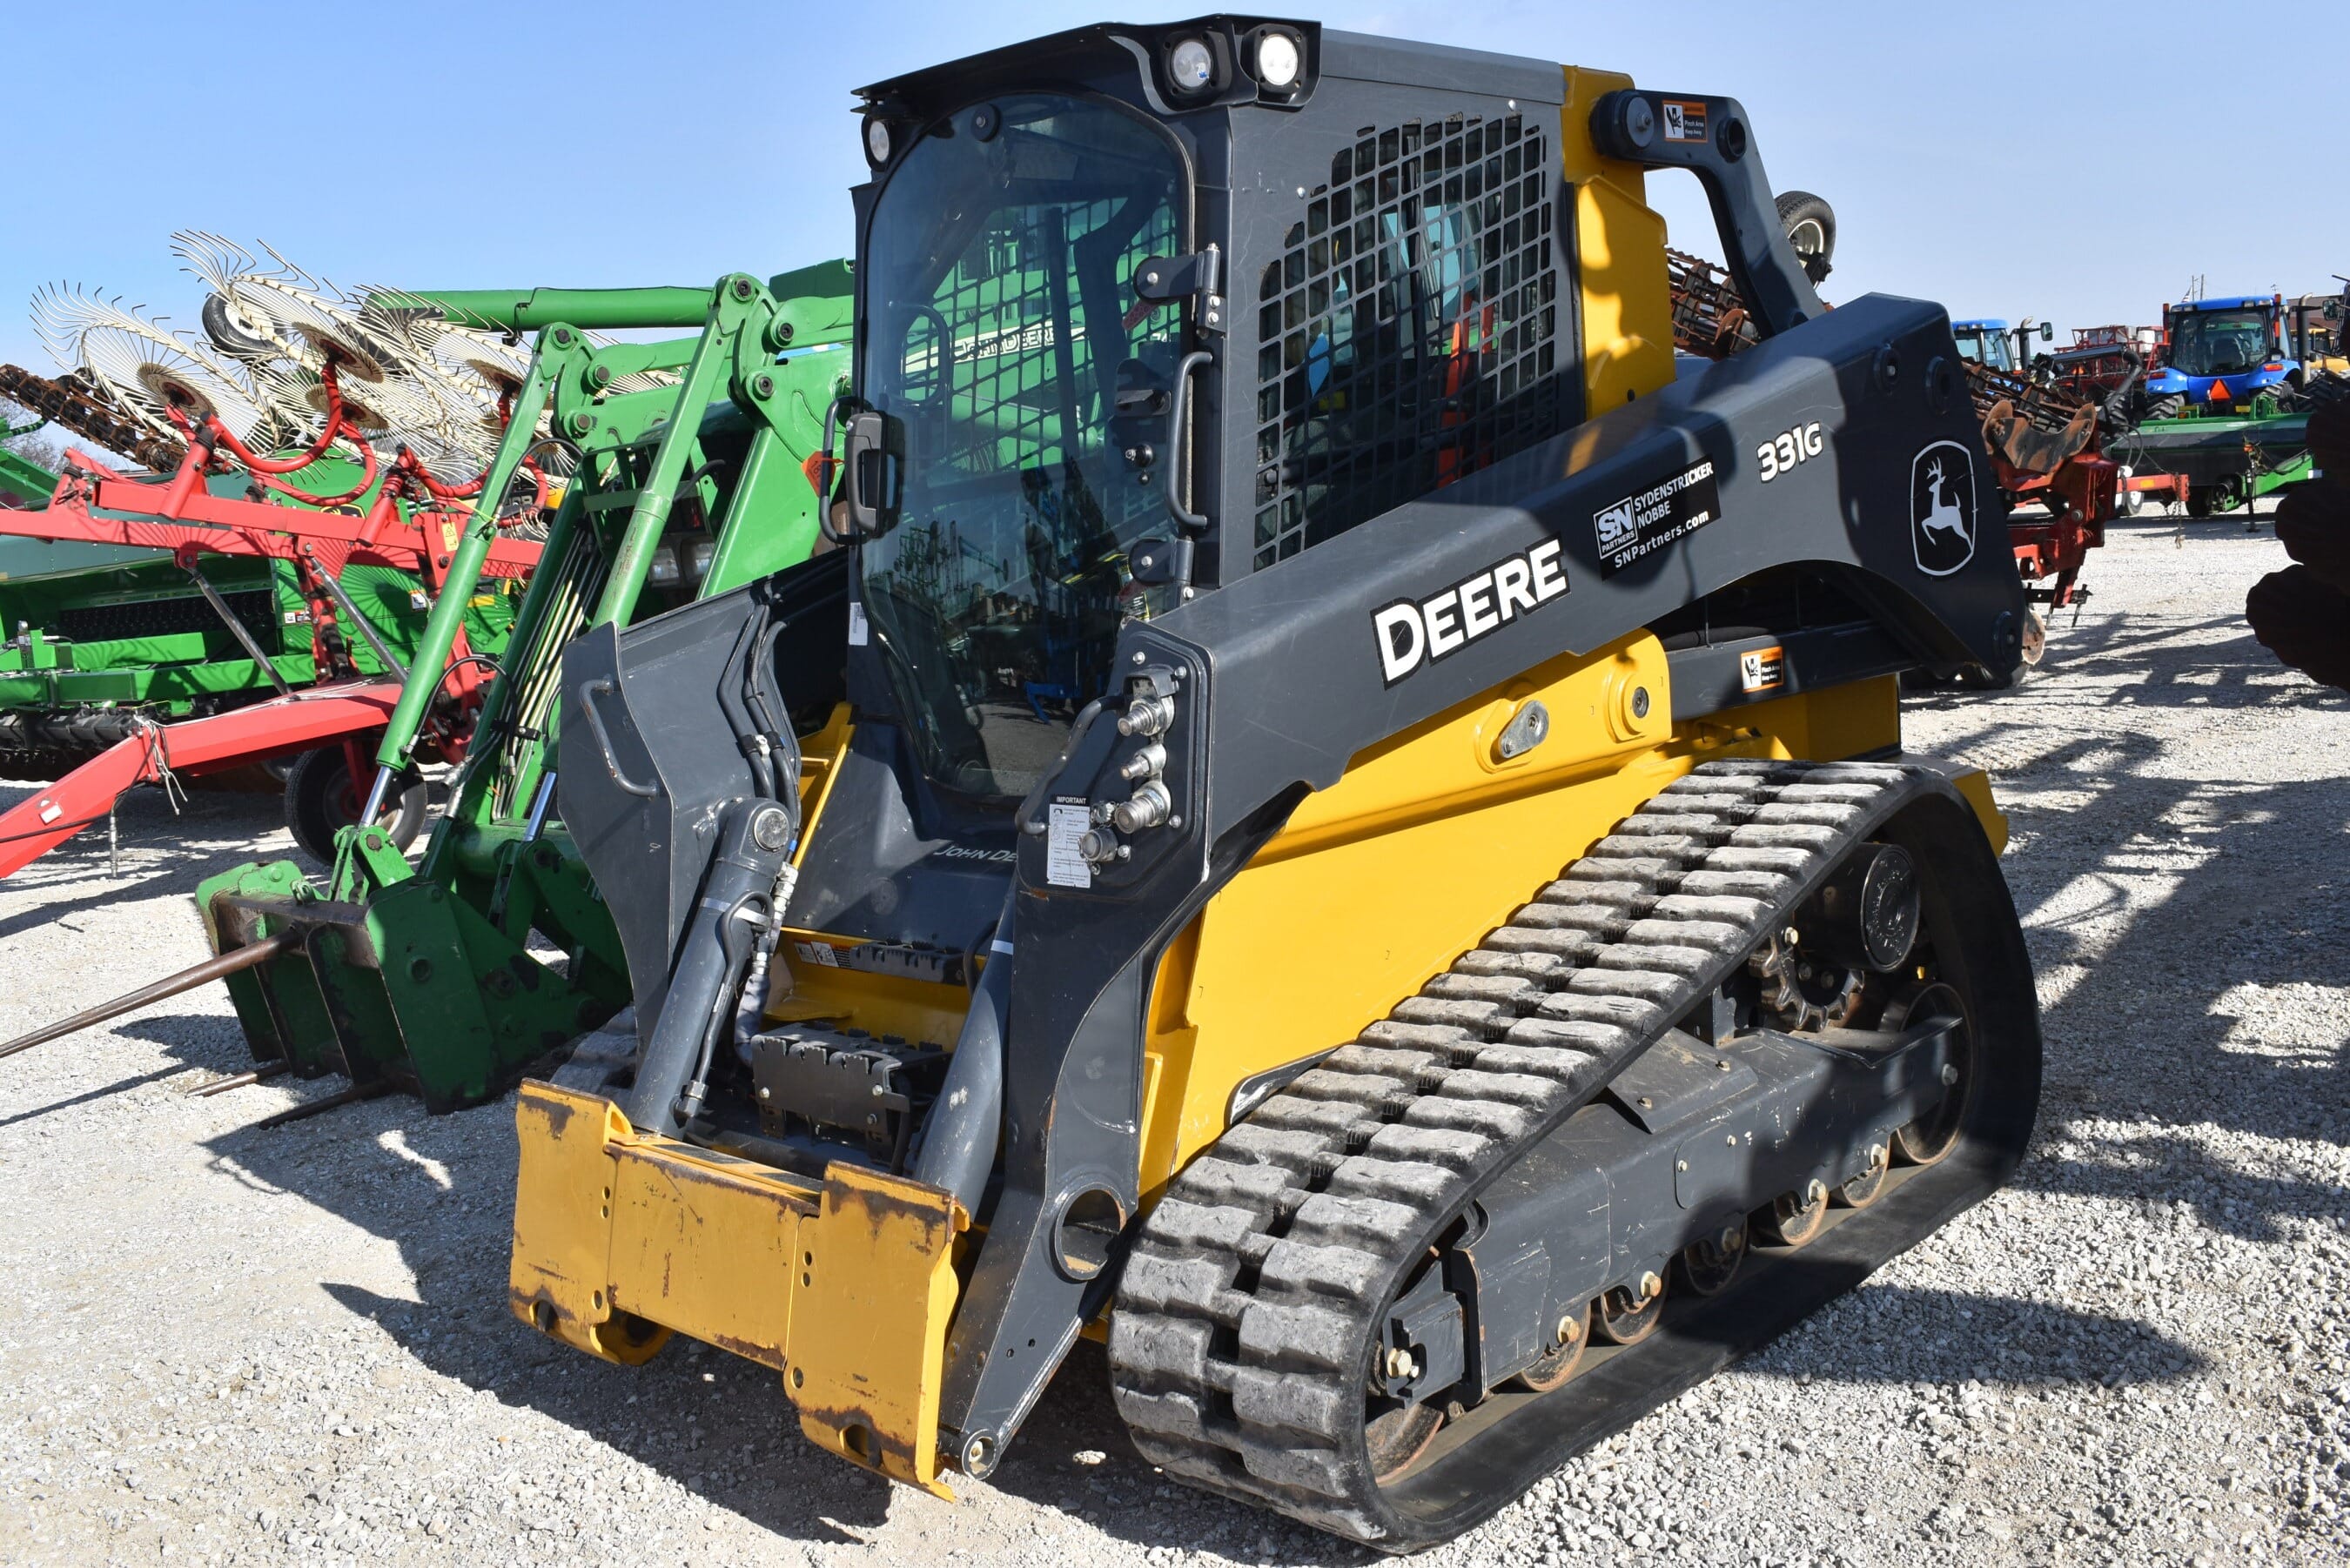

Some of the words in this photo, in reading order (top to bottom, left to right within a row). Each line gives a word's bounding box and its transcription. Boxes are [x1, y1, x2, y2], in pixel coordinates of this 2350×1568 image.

[1756, 421, 1823, 483] 331G
[1634, 461, 1715, 512] SYDENSTRICKER
[1598, 503, 1634, 542] SN
[1636, 500, 1672, 529] NOBBE
[1601, 530, 1635, 553] PARTNERS
[1615, 510, 1710, 568] SNPartners.com
[1373, 538, 1568, 683] DEERE
[1056, 795, 1087, 805] IMPORTANT
[933, 845, 992, 860] JOHN
